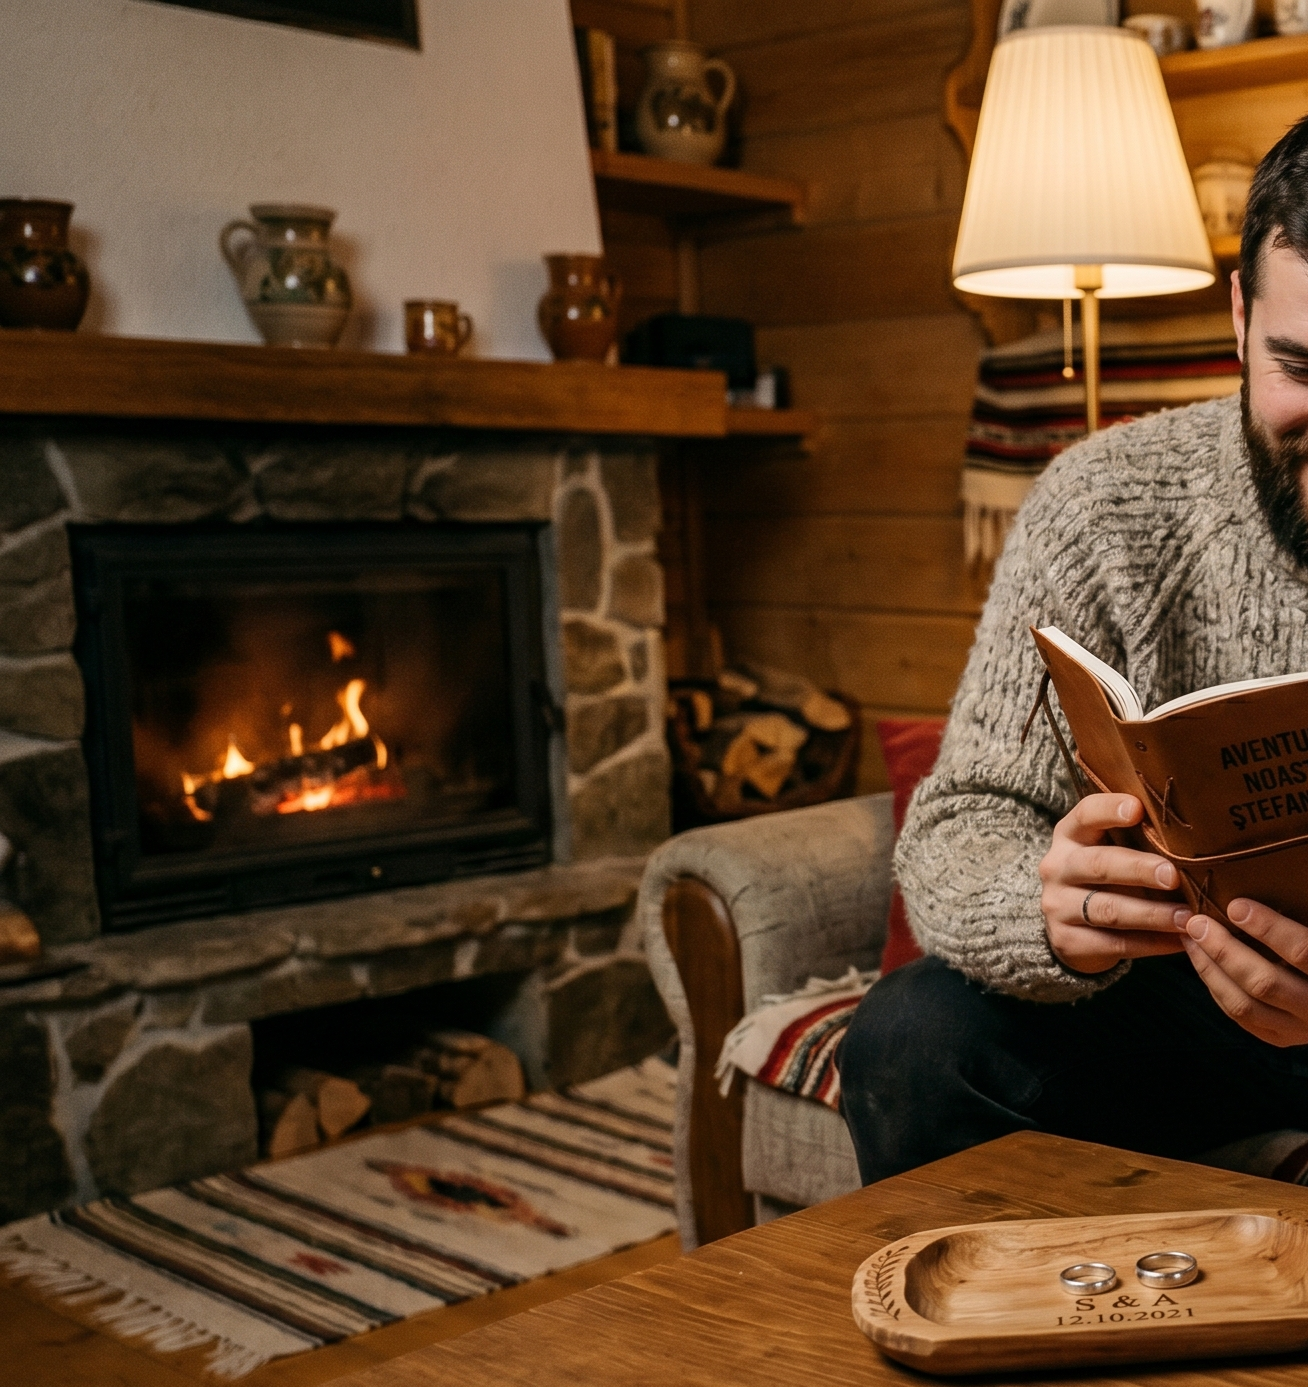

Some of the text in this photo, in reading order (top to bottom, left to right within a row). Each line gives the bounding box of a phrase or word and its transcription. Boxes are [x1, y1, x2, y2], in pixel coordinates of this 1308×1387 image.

[1075, 1293, 1179, 1312] S & A
[1055, 1308, 1195, 1326] 12.10.2021
